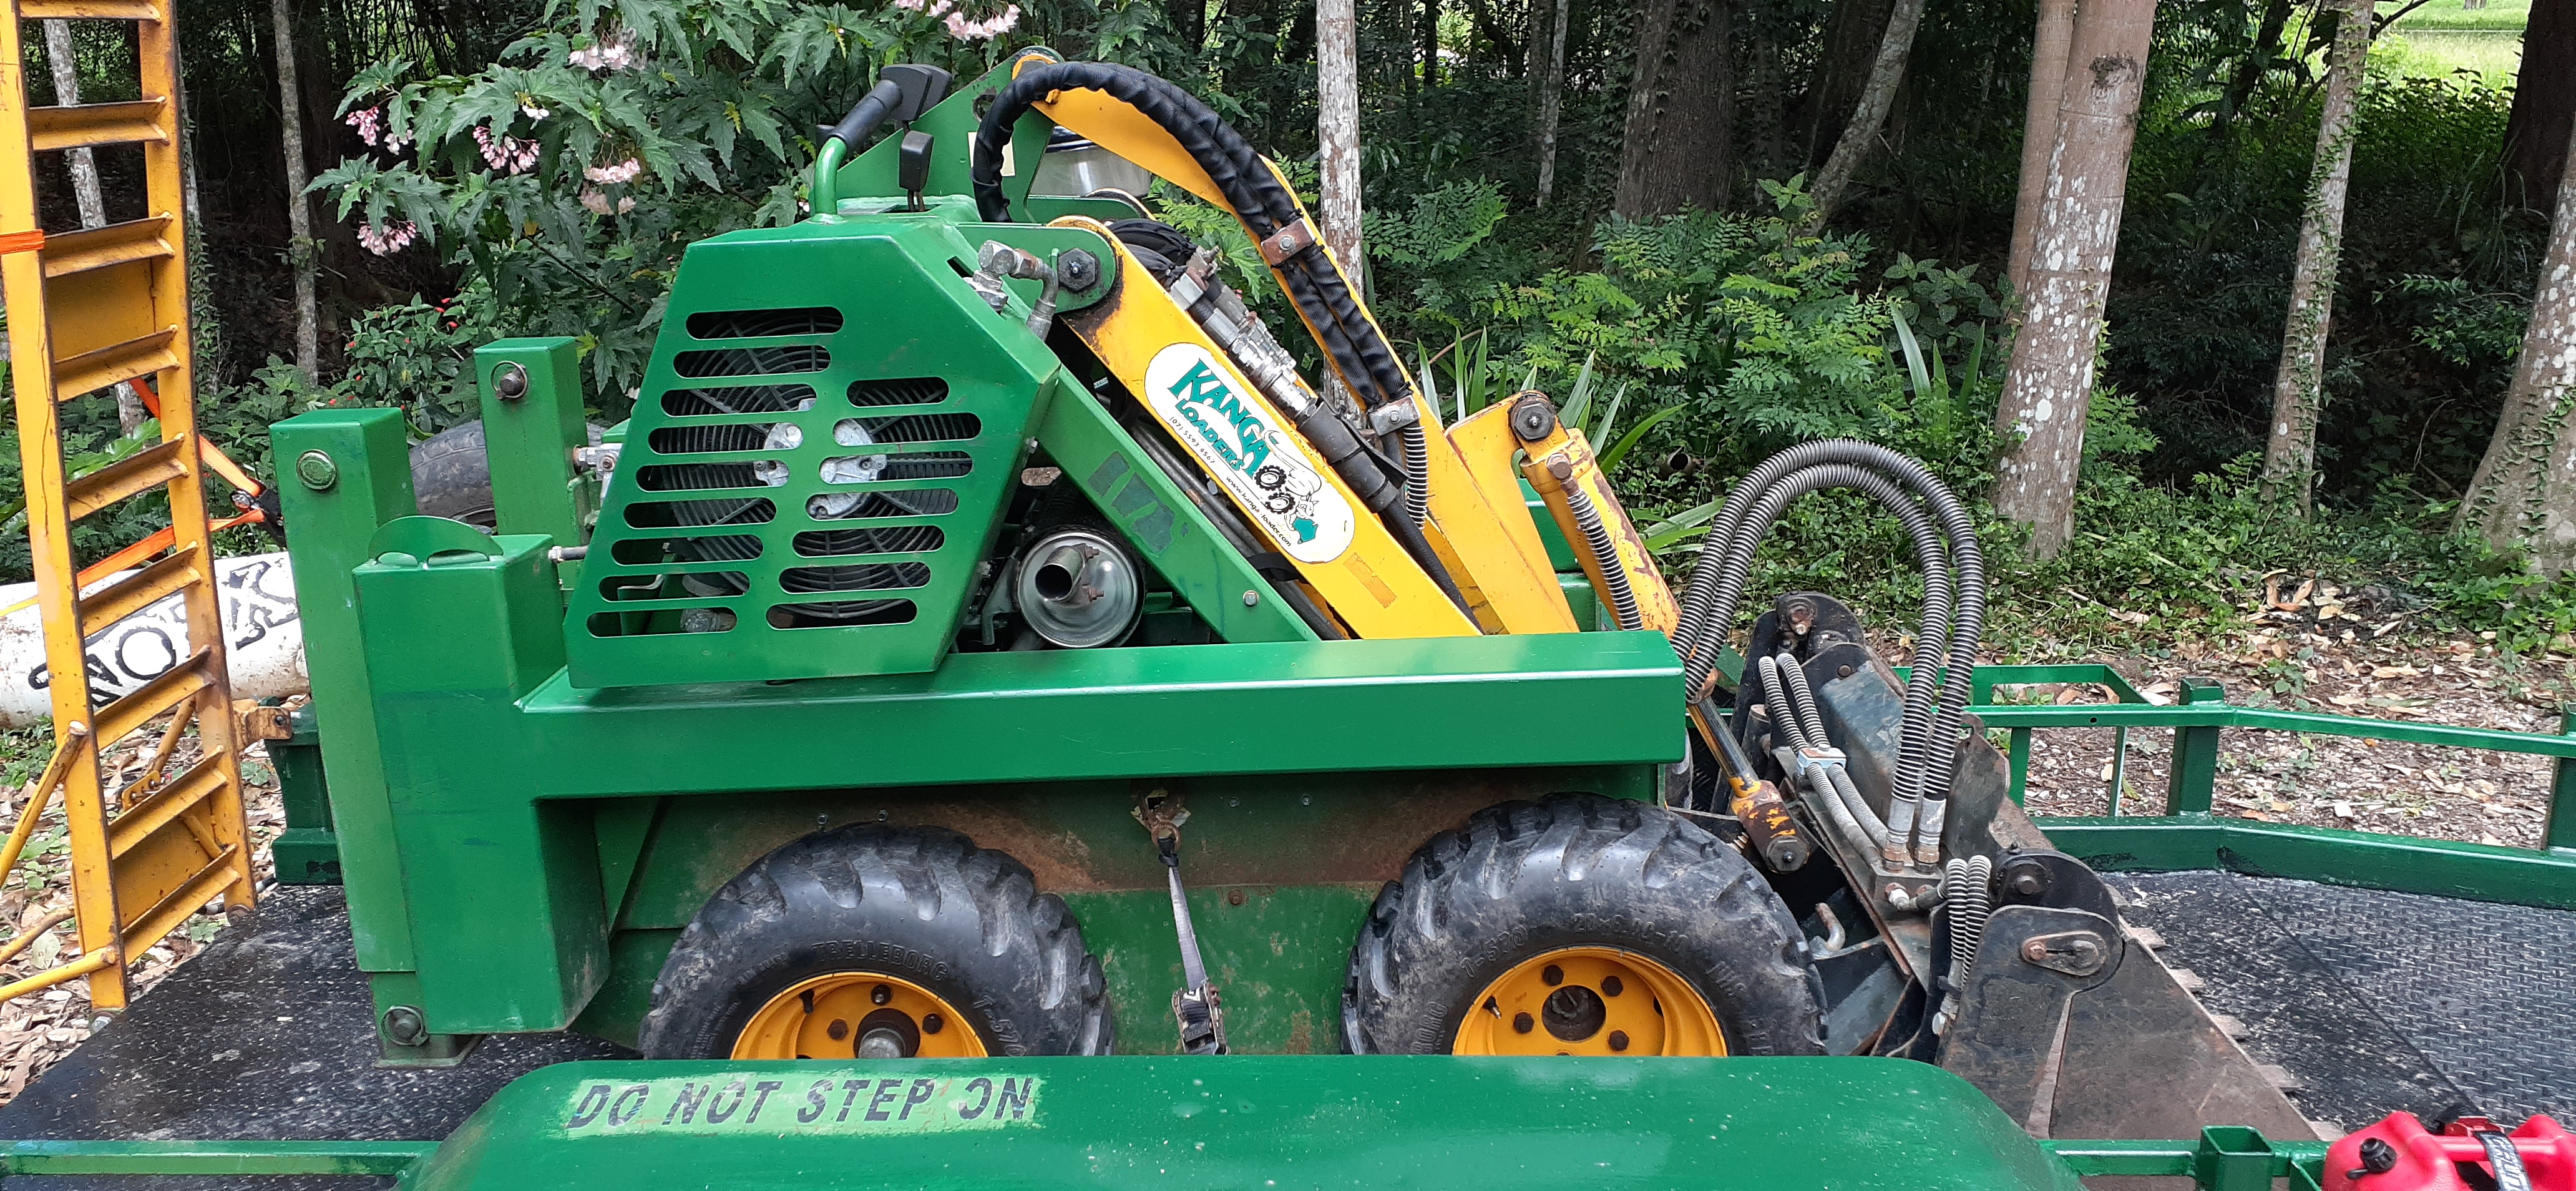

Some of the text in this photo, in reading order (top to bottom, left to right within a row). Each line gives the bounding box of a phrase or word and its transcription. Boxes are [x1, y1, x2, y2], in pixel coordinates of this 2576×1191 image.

[1167, 357, 1271, 480] KANGA
[1174, 398, 1245, 471] LOADERS
[1183, 430, 1199, 447] 5593
[811, 939, 949, 981] TRELLEBORG
[566, 1076, 1035, 1129] DO NOT STEP ON
